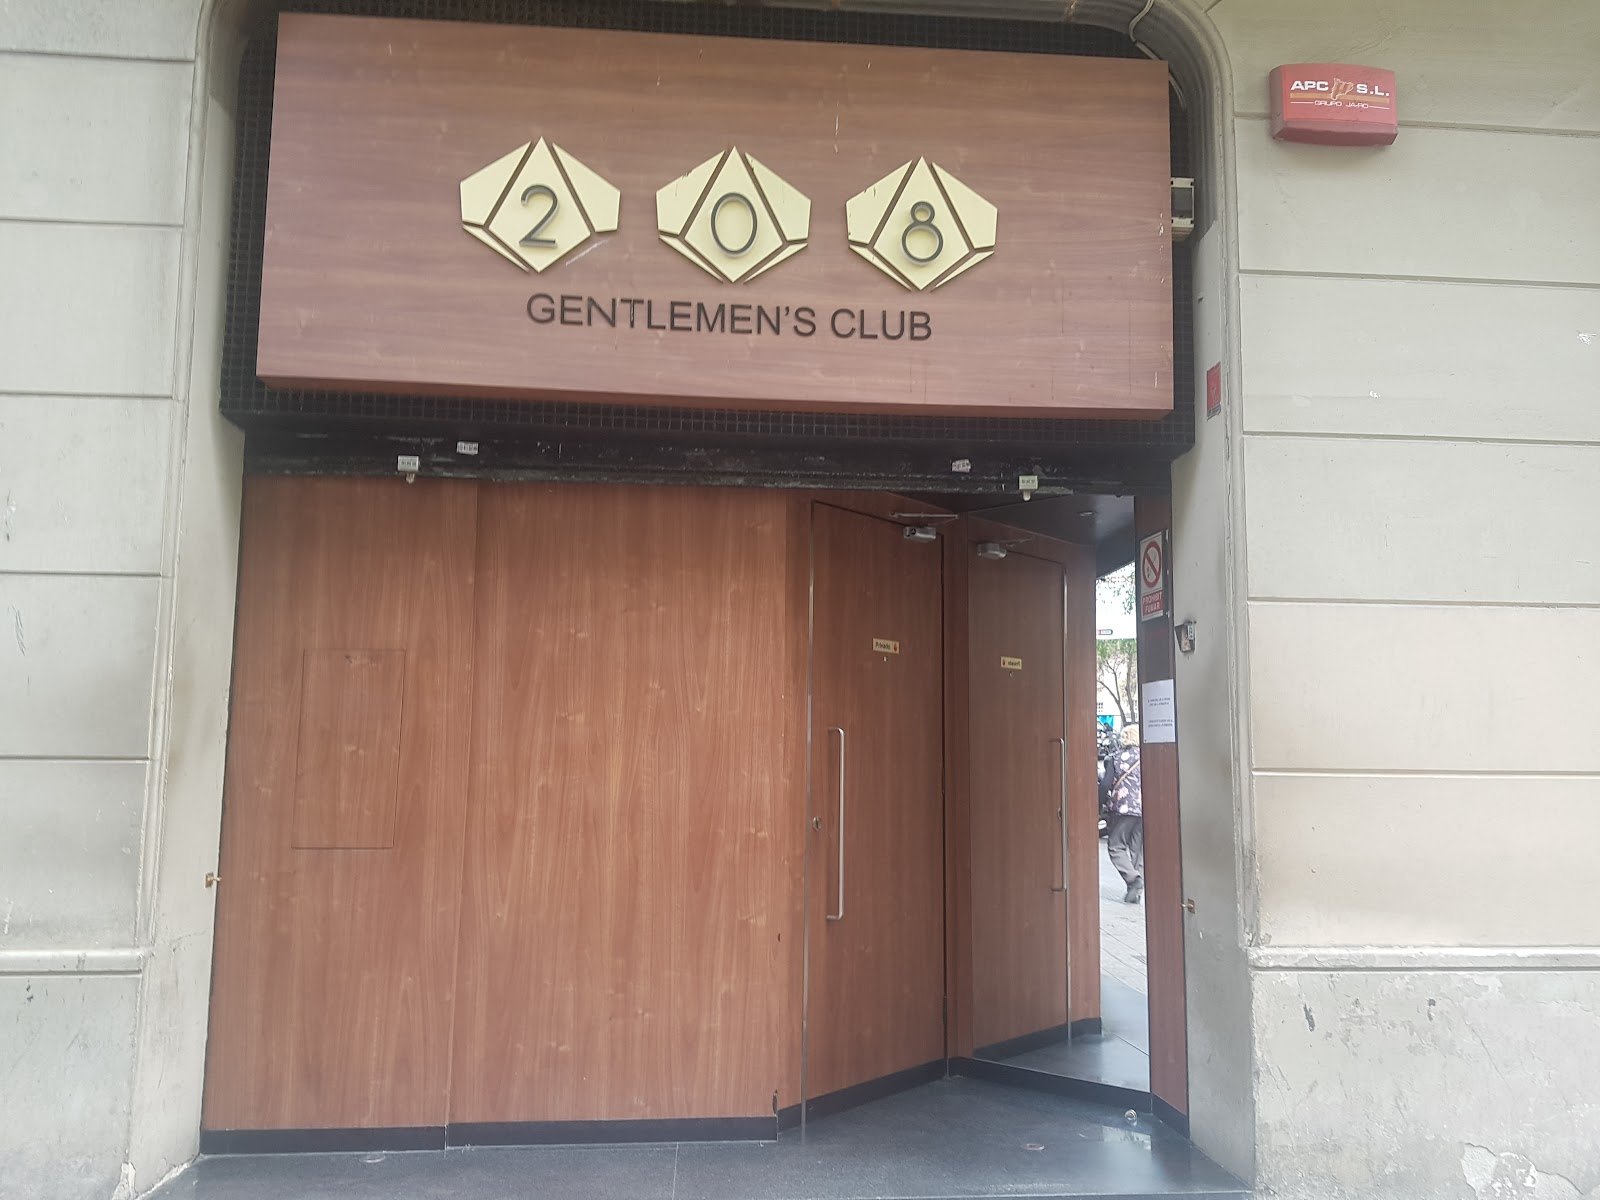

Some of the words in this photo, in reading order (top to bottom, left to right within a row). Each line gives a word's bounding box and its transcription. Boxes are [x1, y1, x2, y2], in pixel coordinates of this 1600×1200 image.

[1290, 80, 1329, 91] APC
[1356, 83, 1390, 97] S.L.
[526, 292, 817, 338] GENTLEMEN'S
[830, 308, 932, 341] CLUB
